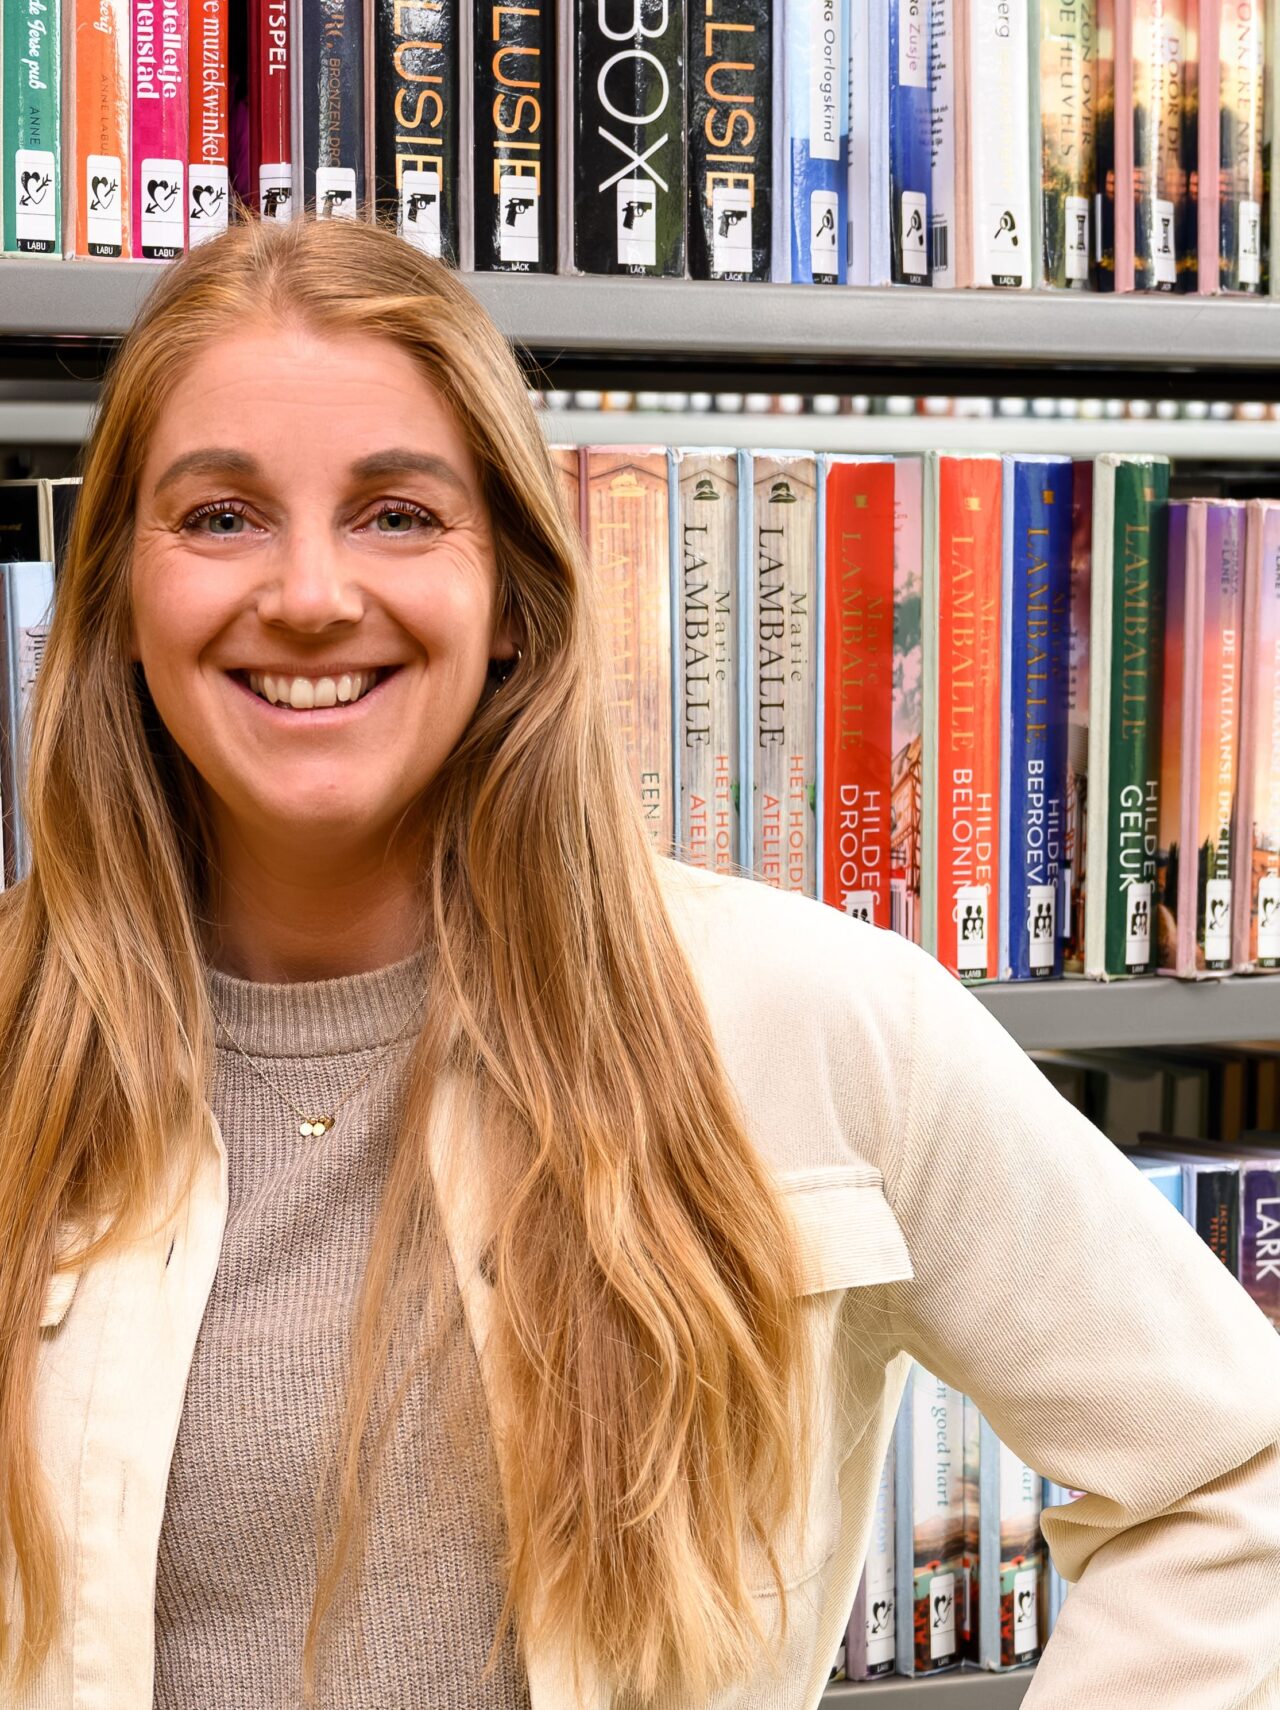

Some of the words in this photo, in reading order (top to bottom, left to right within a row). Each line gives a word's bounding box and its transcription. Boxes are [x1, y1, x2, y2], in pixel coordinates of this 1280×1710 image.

[268, 0, 287, 76] TSPEL
[906, 23, 921, 71] Zusje
[994, 0, 1011, 38] erg
[21, 57, 47, 90] pub
[100, 74, 110, 111] ANNE
[202, 18, 226, 163] muziekwinkel
[329, 58, 341, 131] BRONZEN
[597, 0, 670, 193] BOX
[819, 29, 836, 143] Oorlogskind
[1060, 34, 1077, 156] HEUVELS
[1080, 74, 1093, 145] OVER
[1167, 37, 1180, 116] DOOR
[30, 107, 41, 145] ANNE
[27, 241, 47, 251] LABU
[96, 245, 114, 255] LABU
[153, 248, 175, 258] LABU
[630, 265, 646, 274] LACK
[725, 272, 743, 282] LACK
[1221, 549, 1231, 584] LANE
[683, 523, 711, 748] LAMBALLE
[714, 590, 731, 681] Marie
[758, 525, 785, 748] LAMBALLE
[790, 590, 807, 683] Marie
[840, 532, 864, 750] LAMBALLE
[951, 536, 975, 751] LAMBALLE
[1025, 528, 1049, 743] LAMBALLE
[1122, 523, 1150, 740] LAMBALLE
[1221, 630, 1235, 656] DE
[1219, 662, 1235, 784] ITALIAANSE
[641, 771, 661, 820] EEN
[715, 755, 729, 801] HET
[789, 755, 804, 801] HET
[1119, 785, 1144, 892] GELUK
[1215, 790, 1233, 880] DOCHTE
[1256, 1197, 1280, 1281] LARK
[930, 1405, 949, 1454] goed
[936, 1460, 952, 1507] hart
